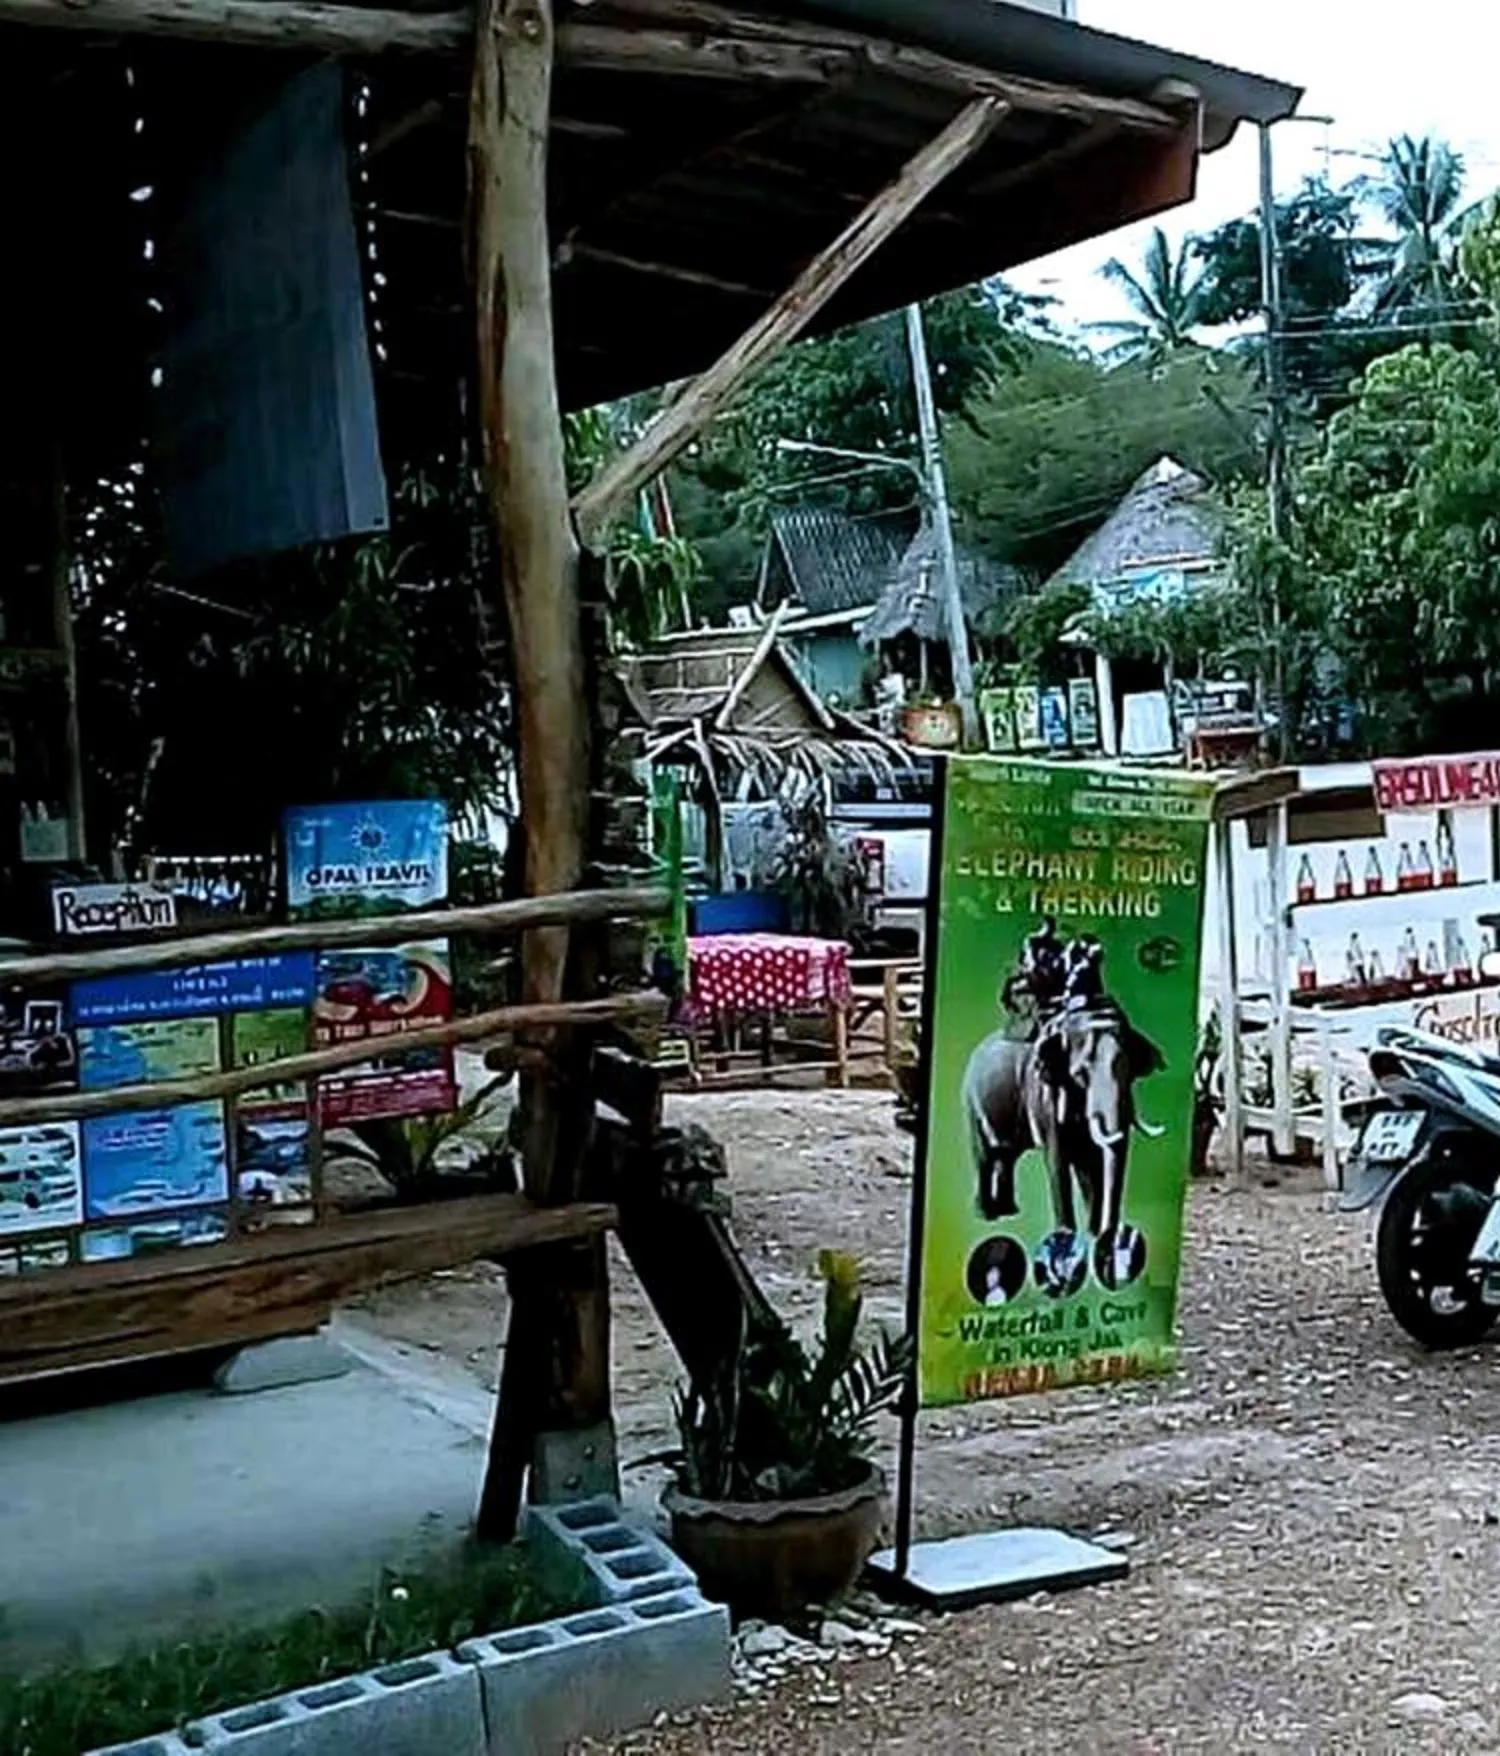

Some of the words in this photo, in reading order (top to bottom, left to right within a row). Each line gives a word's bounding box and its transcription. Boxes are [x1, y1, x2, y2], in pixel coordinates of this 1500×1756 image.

[305, 866, 359, 886] OPAL
[955, 849, 1098, 882] ELEPHANT
[1110, 853, 1198, 886] RIDING
[958, 1308, 1065, 1342] Waterfall
[1075, 1305, 1091, 1329] &
